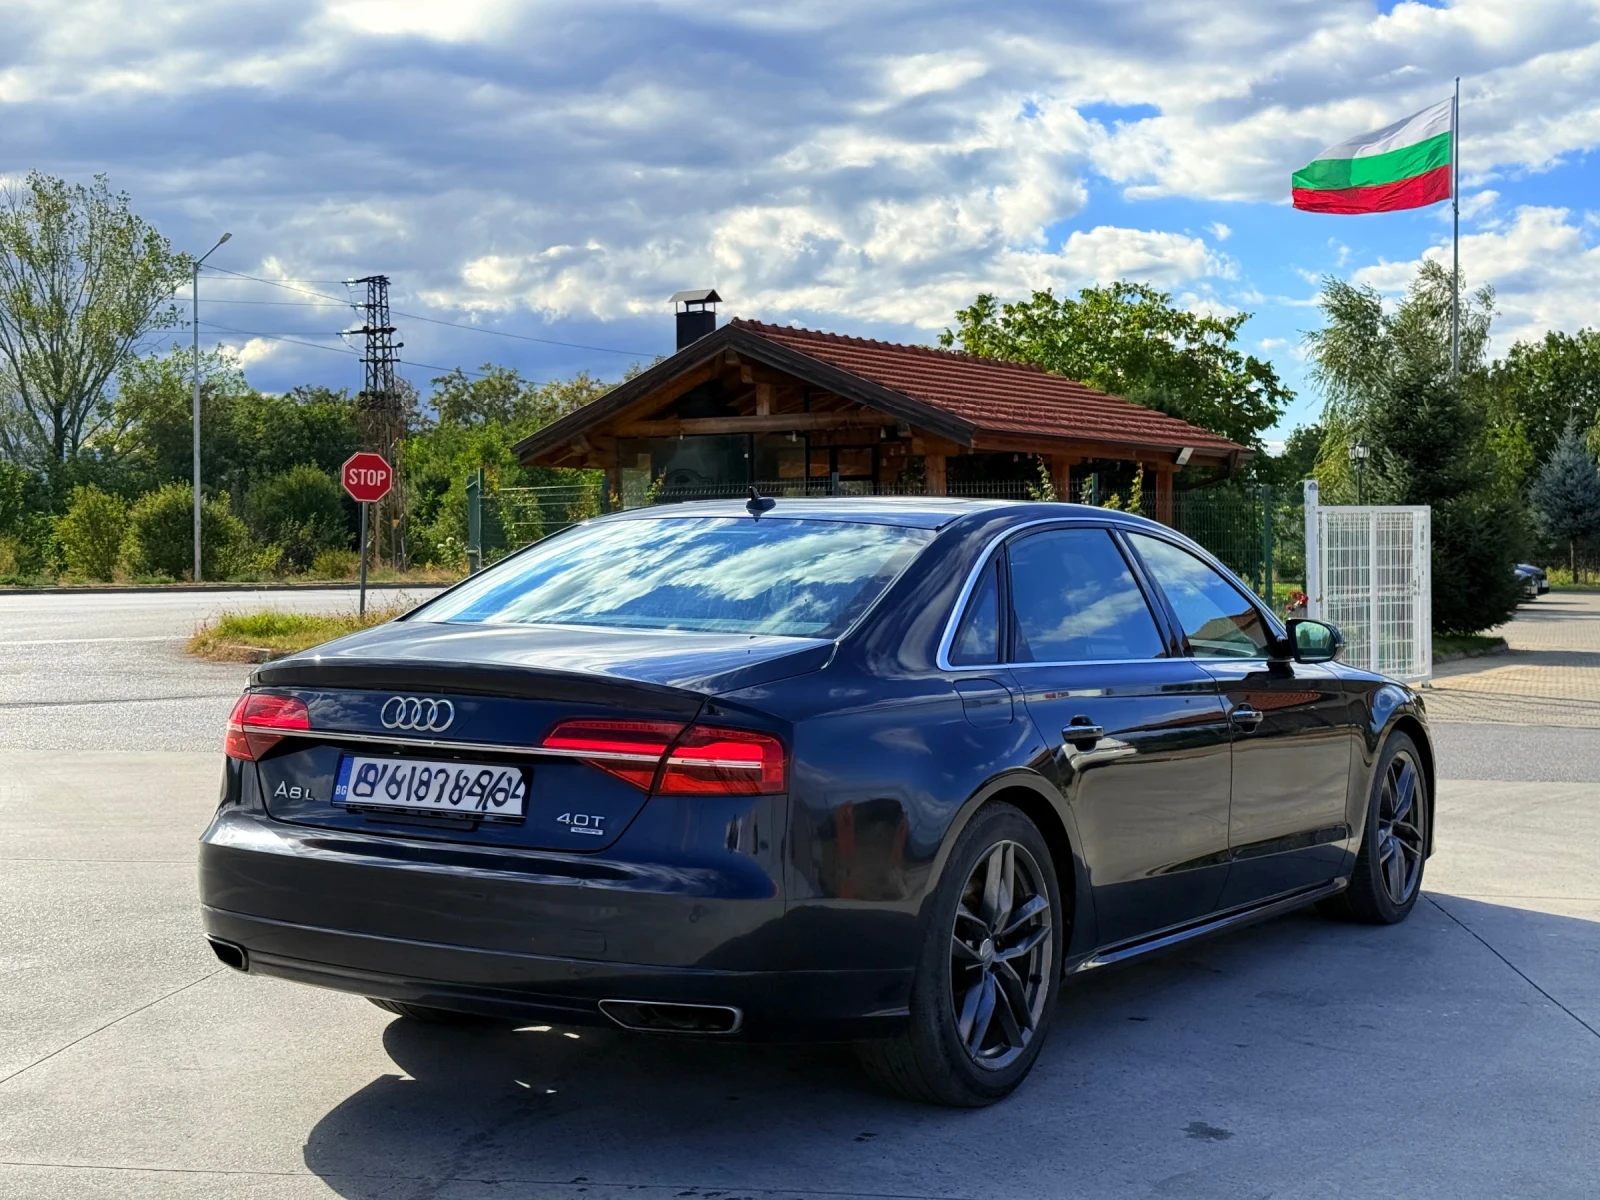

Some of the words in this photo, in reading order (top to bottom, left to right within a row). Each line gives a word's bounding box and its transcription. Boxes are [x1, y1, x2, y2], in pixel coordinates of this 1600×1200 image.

[349, 468, 387, 487] STOP
[335, 784, 347, 796] BG
[556, 812, 606, 828] 4.0T
